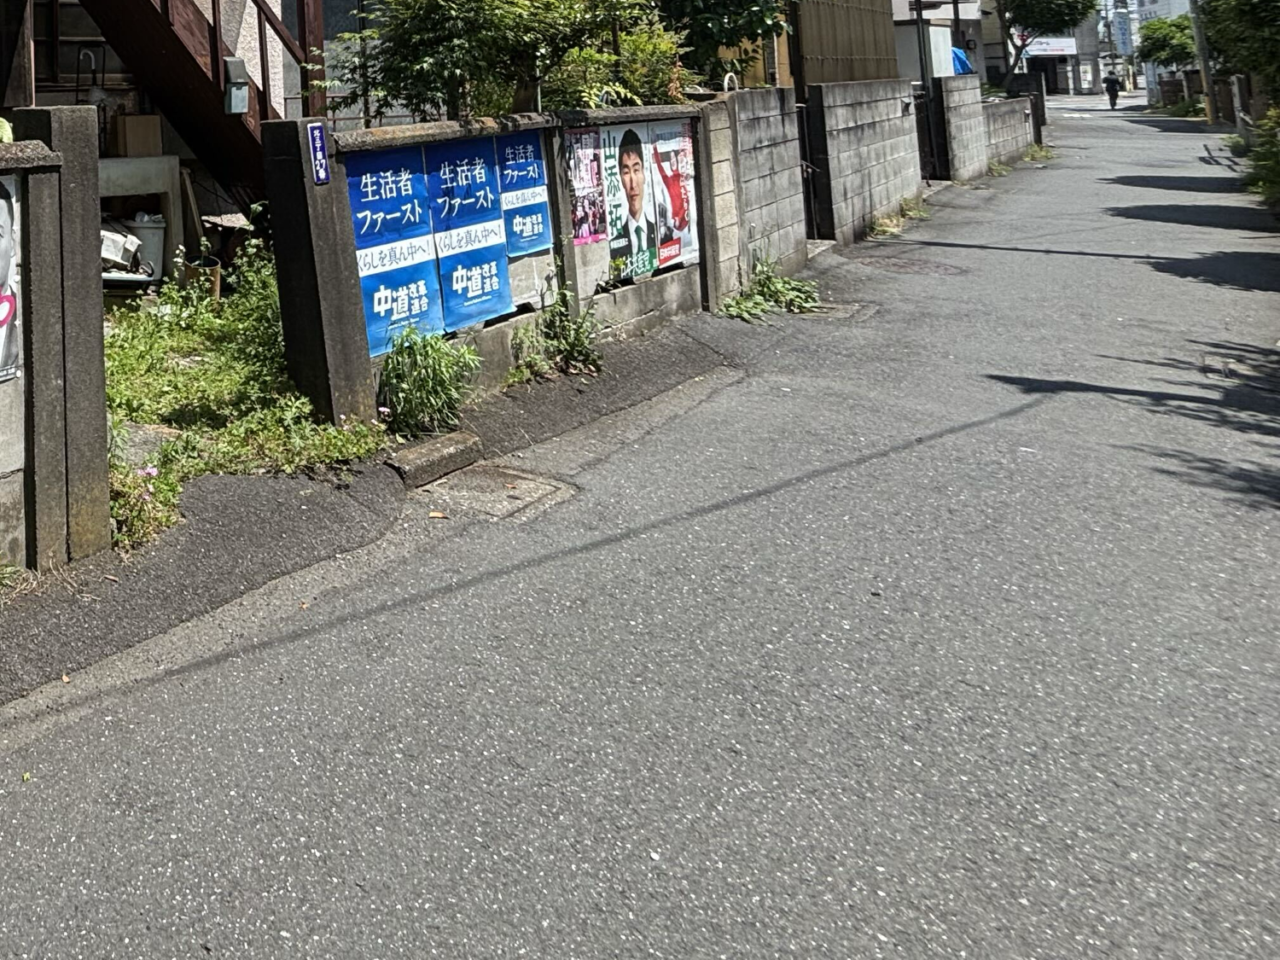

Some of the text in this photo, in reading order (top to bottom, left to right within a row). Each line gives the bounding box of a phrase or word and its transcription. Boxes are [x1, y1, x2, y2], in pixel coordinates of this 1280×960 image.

[505, 144, 535, 165] 生活者
[360, 167, 412, 202] 生活者
[440, 157, 486, 189] 生活者
[503, 163, 538, 184] ファースト
[603, 130, 623, 237] 山添拓
[356, 199, 422, 234] ファースト
[437, 186, 494, 218] ファースト
[438, 224, 502, 253] くらしを真ん中へ！
[408, 280, 428, 298] 改革
[452, 265, 482, 298] 中道
[373, 285, 409, 321] 中道
[410, 296, 429, 315] 連合
